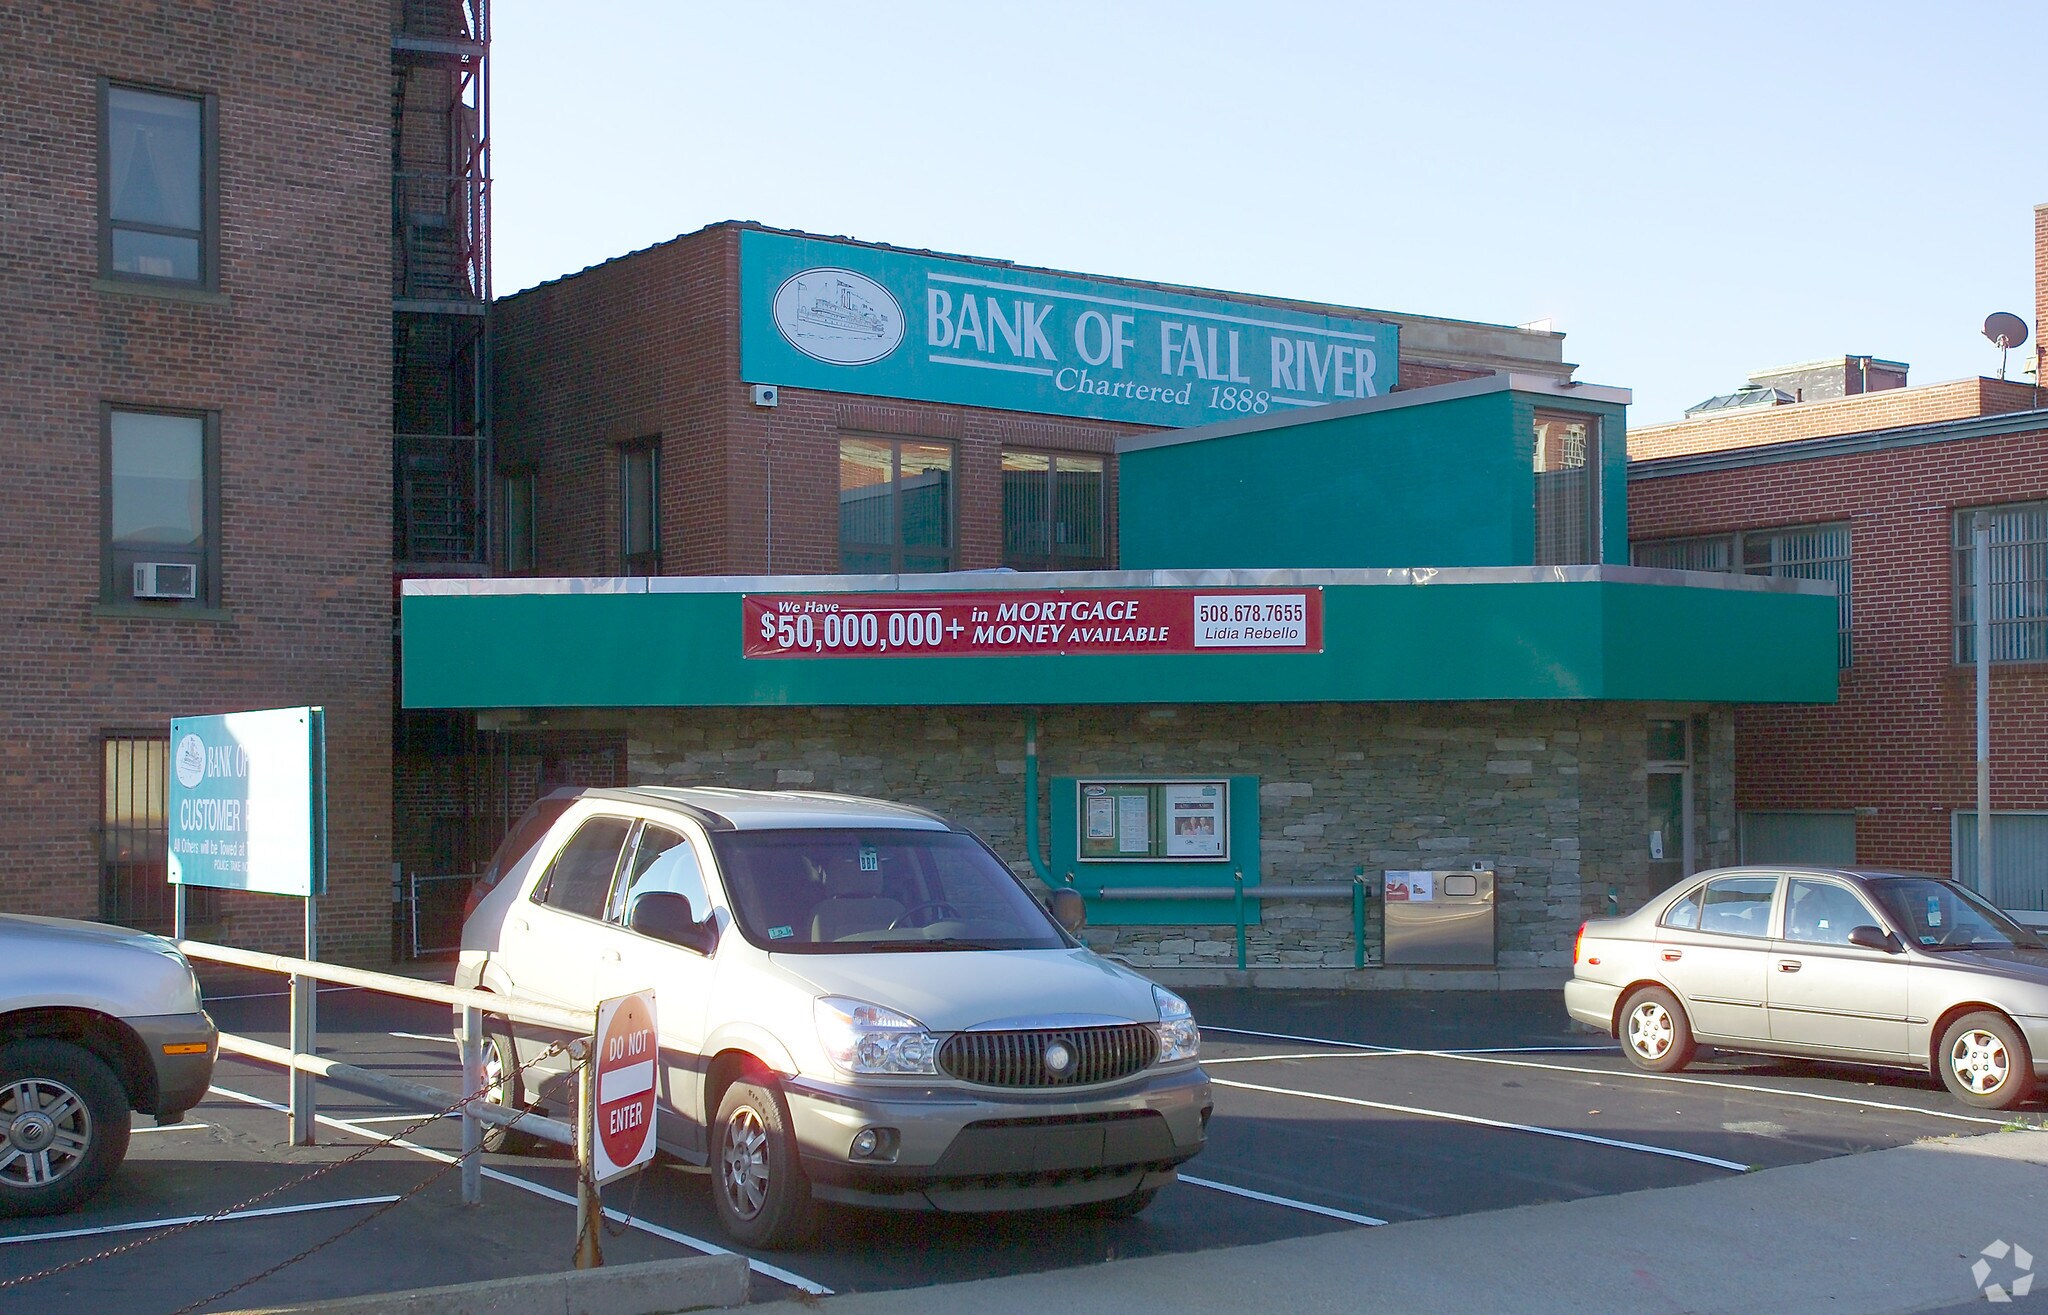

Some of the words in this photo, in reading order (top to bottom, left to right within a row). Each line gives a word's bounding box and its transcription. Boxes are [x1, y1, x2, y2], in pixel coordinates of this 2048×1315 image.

[928, 288, 1058, 361] BANK
[1074, 310, 1134, 369] OF
[1160, 320, 1250, 384] FALL
[1271, 335, 1377, 398] RIVER
[1055, 367, 1192, 405] Chartered
[1208, 384, 1270, 414] 1888
[778, 601, 800, 613] We
[804, 601, 839, 613] Have
[971, 607, 989, 622] in
[996, 600, 1139, 621] MORTGAGE
[1200, 604, 1303, 622] 508.678.7655
[971, 624, 1066, 644] MONEY
[1067, 626, 1170, 643] AVAILABLE
[1205, 627, 1239, 639] Lidia
[1244, 626, 1298, 639] Rebello
[207, 745, 233, 778] BANK
[180, 798, 241, 832] CUSTOMER
[181, 838, 199, 854] Others
[210, 840, 218, 855] be
[219, 840, 238, 856] Towed
[238, 841, 245, 857] at
[609, 1034, 625, 1062] DO
[628, 1029, 648, 1057] NOT
[610, 1101, 643, 1135] ENTER
